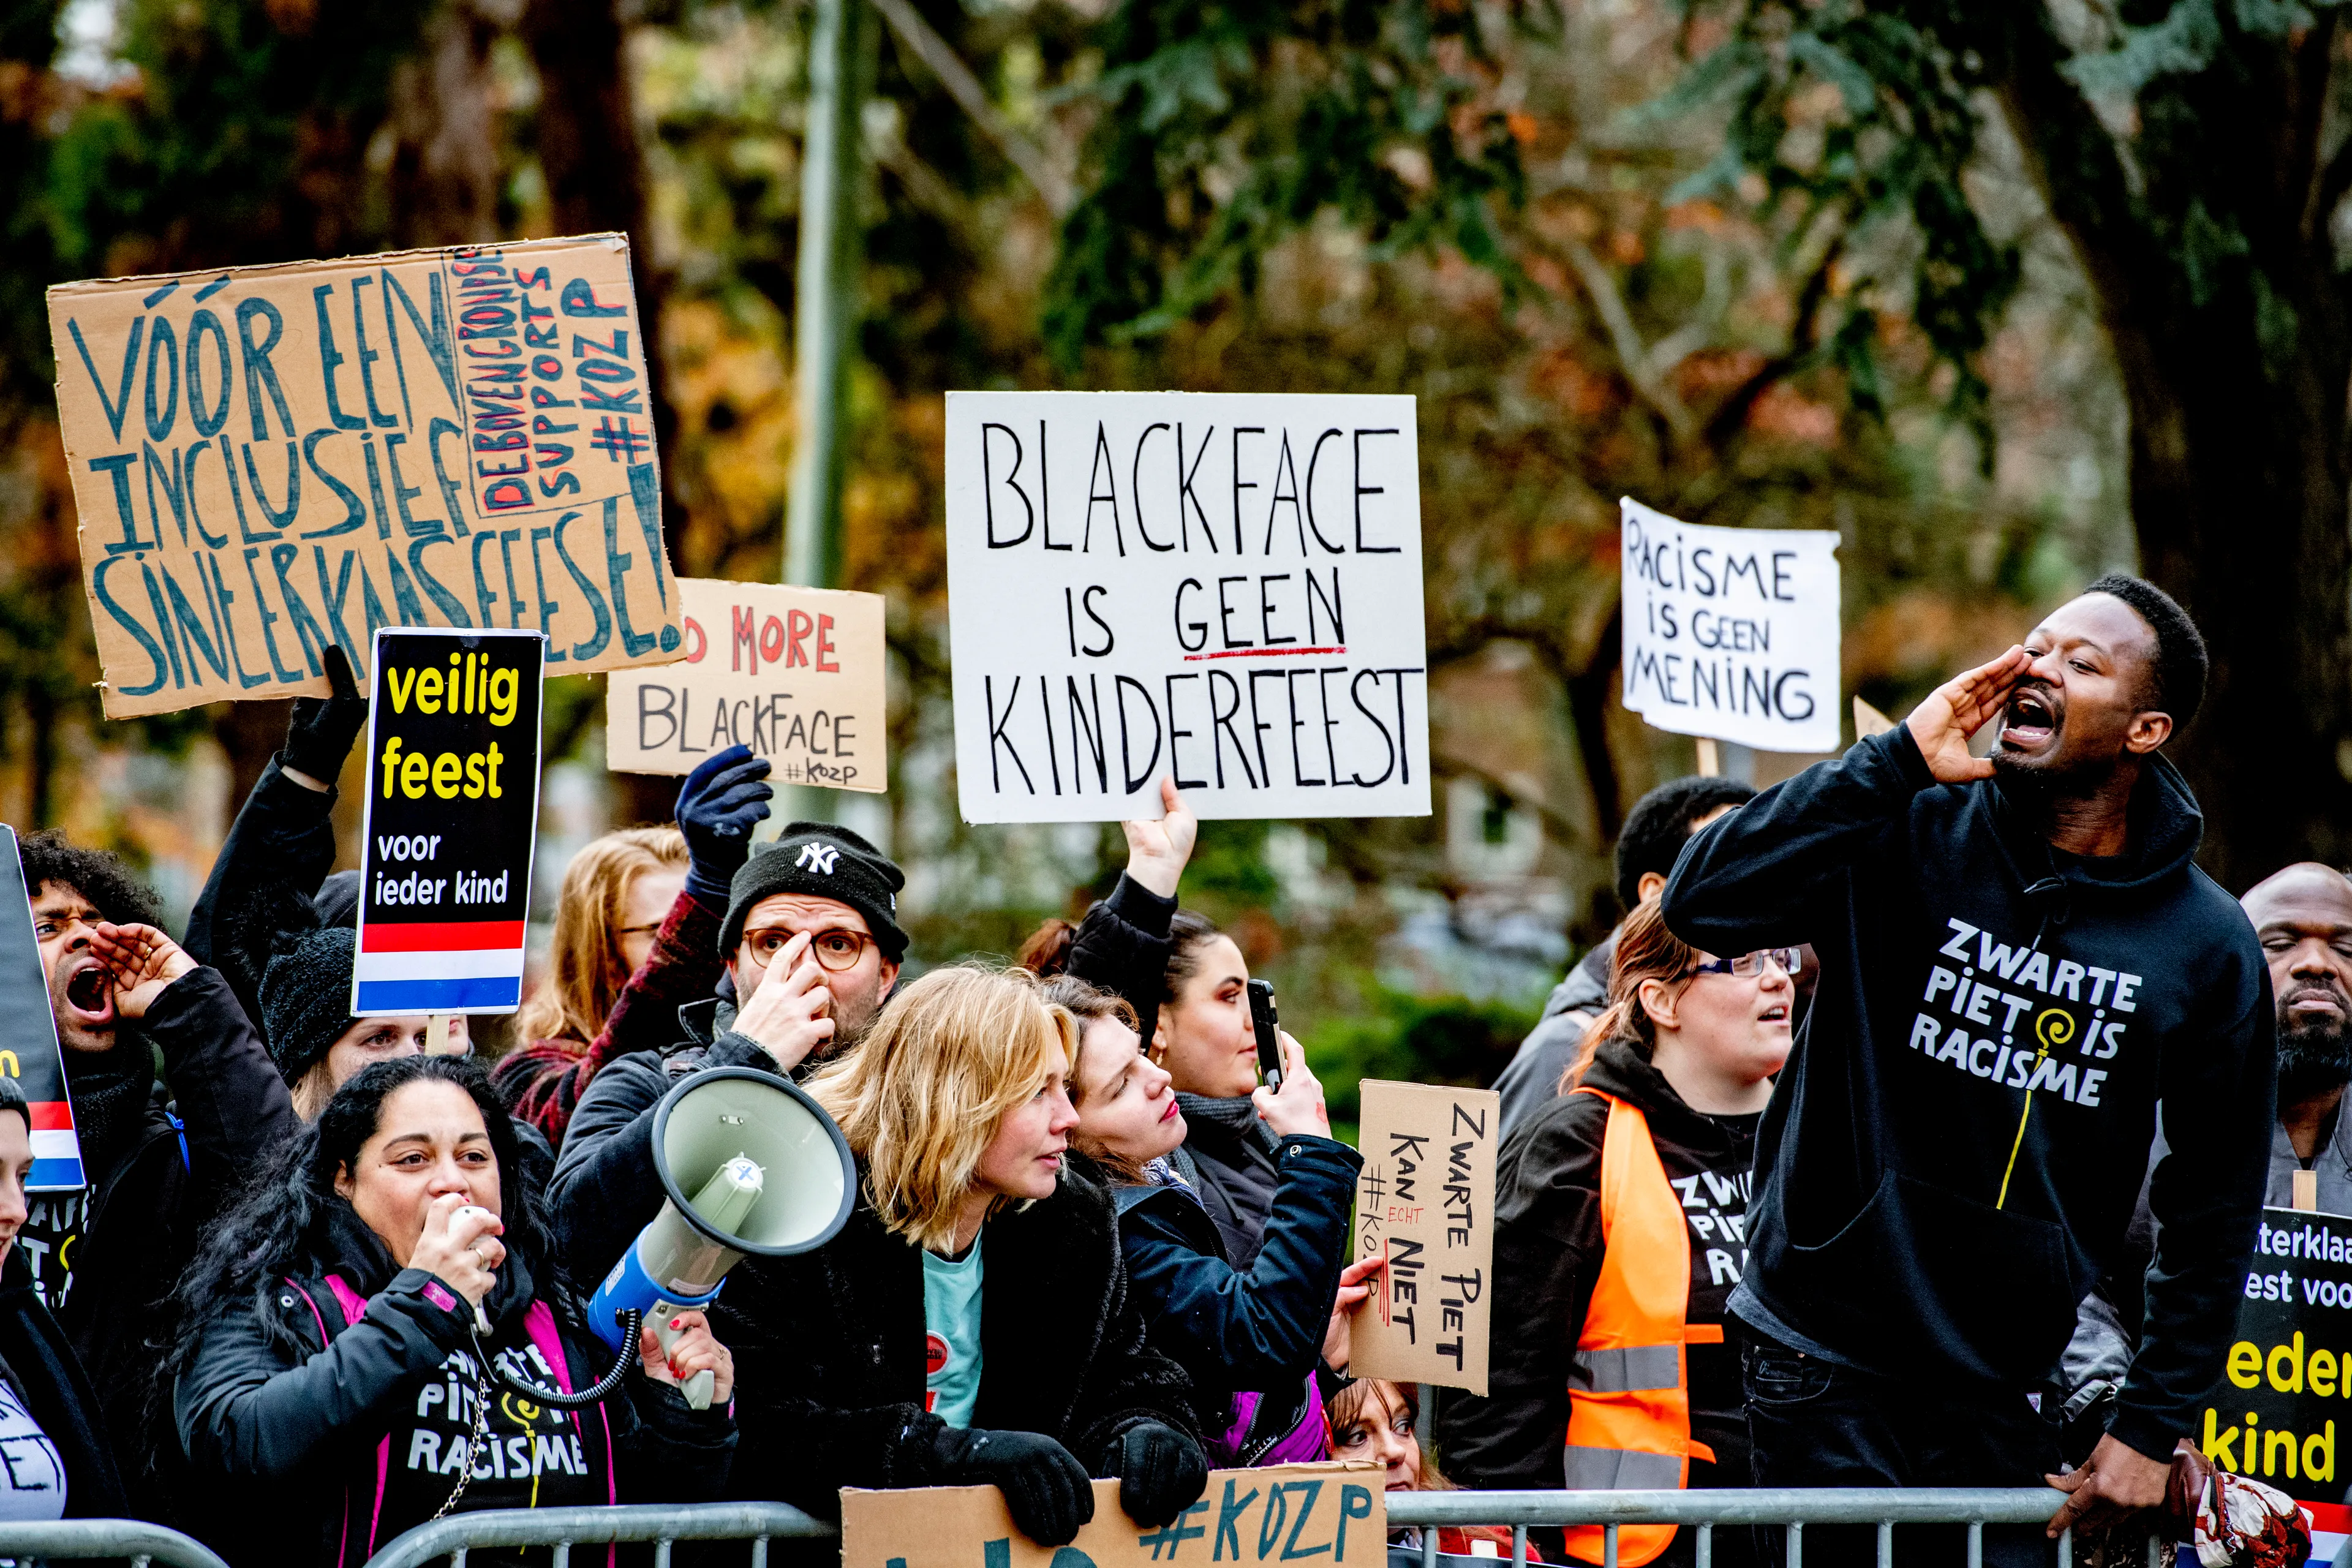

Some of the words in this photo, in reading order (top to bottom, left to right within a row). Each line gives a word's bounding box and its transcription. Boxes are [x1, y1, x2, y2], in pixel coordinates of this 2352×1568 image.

[66, 274, 296, 444] VÓÓR
[313, 266, 462, 434] EEN
[513, 266, 581, 498] SUPPORTS
[560, 277, 650, 464] #KOZP
[982, 420, 1402, 557] BLACKFACE
[731, 605, 840, 675] MORE
[1065, 585, 1115, 658] IS
[1174, 567, 1346, 652] GEEN
[1692, 609, 1770, 654] GEEN
[388, 652, 518, 726] veilig
[638, 684, 856, 757] BLACKFACE
[382, 736, 503, 799] feest
[984, 667, 1425, 795] KINDERFEEST
[375, 870, 447, 905] ieder
[454, 869, 508, 904] kind
[379, 834, 441, 861] voor
[1939, 918, 2143, 1012] ZWARTE
[1390, 1133, 1430, 1201] KAN
[1442, 1102, 1485, 1249] ZWARTE
[1388, 1207, 1423, 1224] ECHT
[1389, 1237, 1425, 1344] NIET
[1436, 1268, 1482, 1371] PIET
[2303, 1278, 2352, 1310] voo
[2203, 1408, 2335, 1482] kind
[1139, 1477, 1373, 1563] #KOZP
